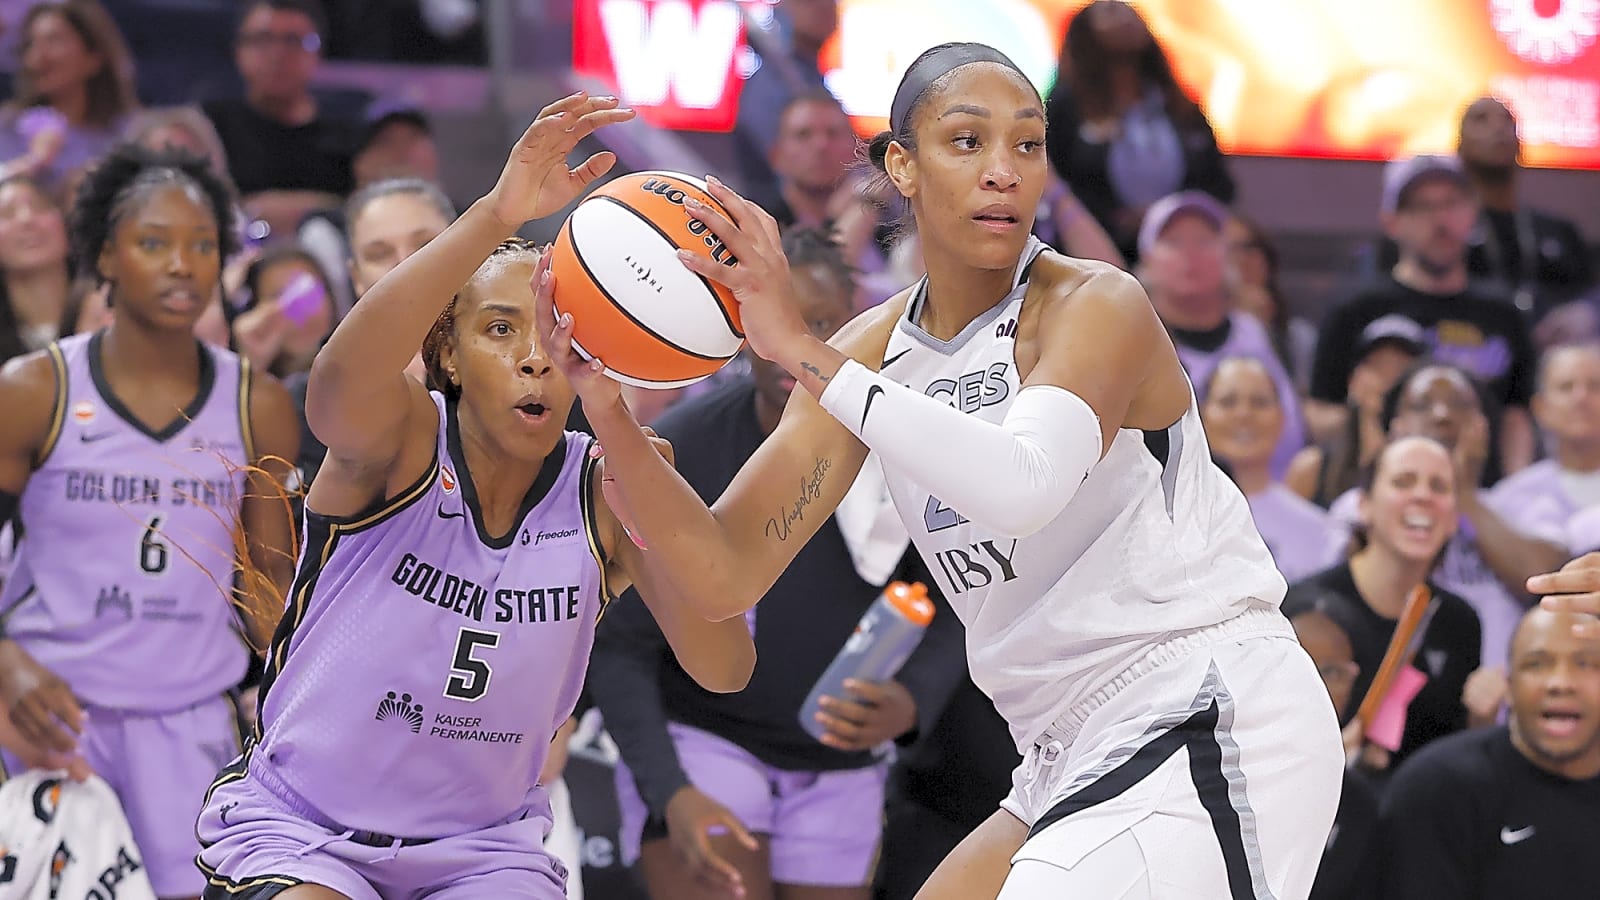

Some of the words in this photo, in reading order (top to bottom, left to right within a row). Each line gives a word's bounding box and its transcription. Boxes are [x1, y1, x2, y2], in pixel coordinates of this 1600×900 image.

[66, 472, 160, 503] GOLDEN
[765, 457, 832, 541] Unapologetic
[139, 516, 167, 574] 6
[534, 529, 579, 546] freedom
[391, 552, 488, 622] GOLDEN
[494, 585, 580, 624] STATE
[443, 626, 500, 702] 5
[430, 727, 524, 744] PERMANENTE
[434, 713, 482, 728] KAISER
